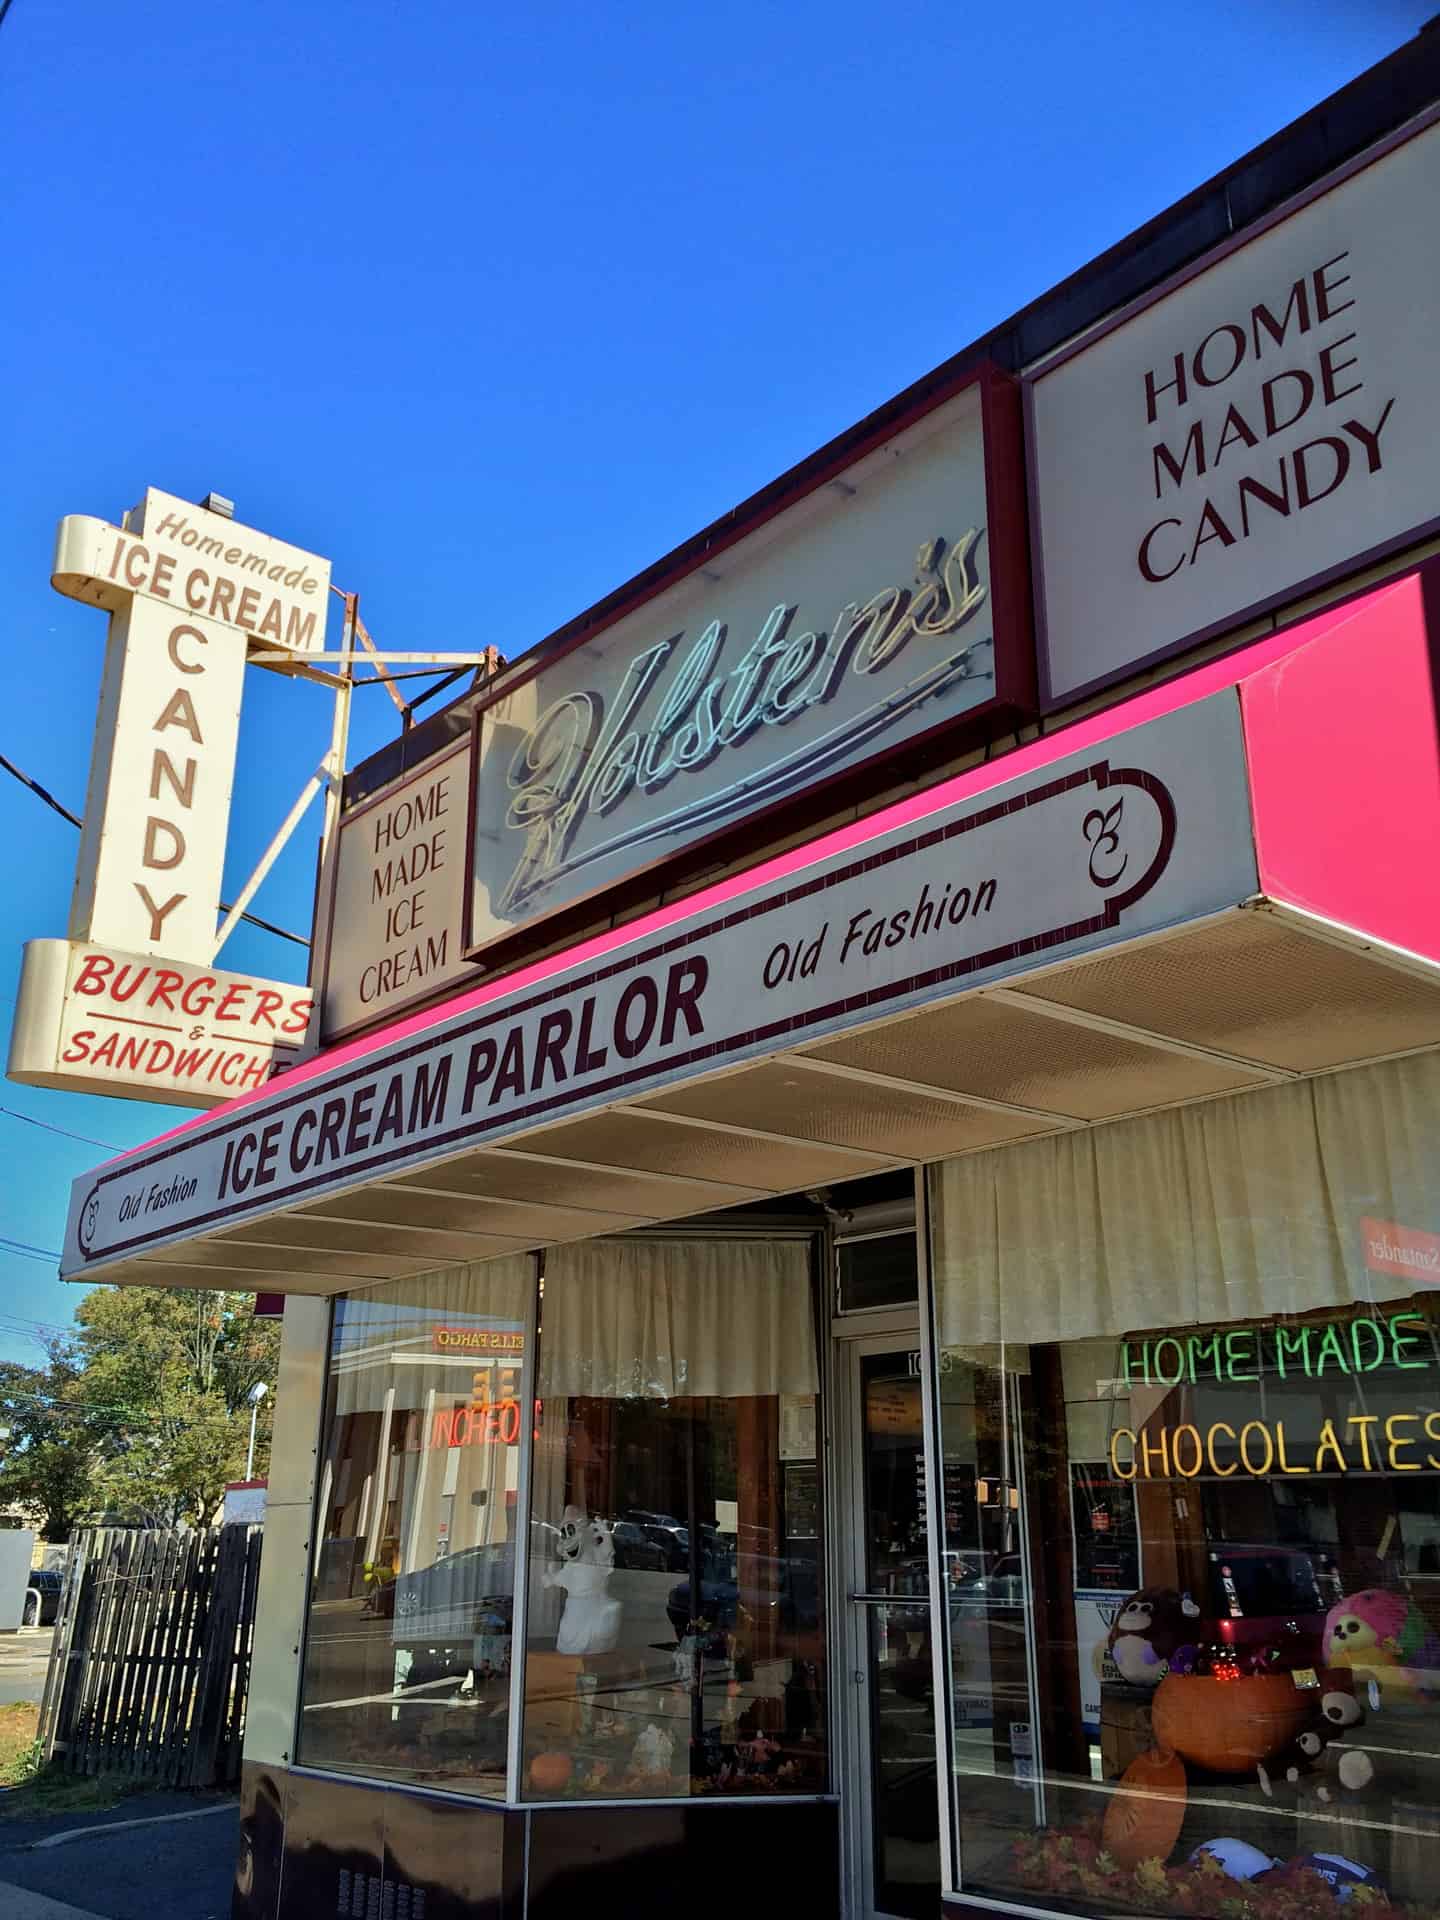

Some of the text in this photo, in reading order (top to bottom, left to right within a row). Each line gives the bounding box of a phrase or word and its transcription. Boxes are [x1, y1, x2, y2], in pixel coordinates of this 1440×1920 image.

[1144, 250, 1356, 425] HOME
[1152, 332, 1364, 499] MADE
[1137, 397, 1396, 583] CANDY
[154, 510, 320, 596] Homemade
[108, 538, 317, 651] ICE CREAM
[133, 623, 210, 943] CANDY
[374, 775, 451, 854] HOME
[371, 828, 446, 905] MADE
[386, 889, 426, 945] ICE
[763, 878, 998, 990] Old Fashion
[74, 953, 315, 1034] BURGERS
[359, 928, 448, 1005] CREAM
[189, 1025, 206, 1041] &
[218, 954, 710, 1200] ICE CREAM PARLOR
[118, 1174, 198, 1223] Old Fashion
[1121, 1312, 1431, 1389] HOME MADE
[1110, 1411, 1440, 1480] CHOCOLATES
